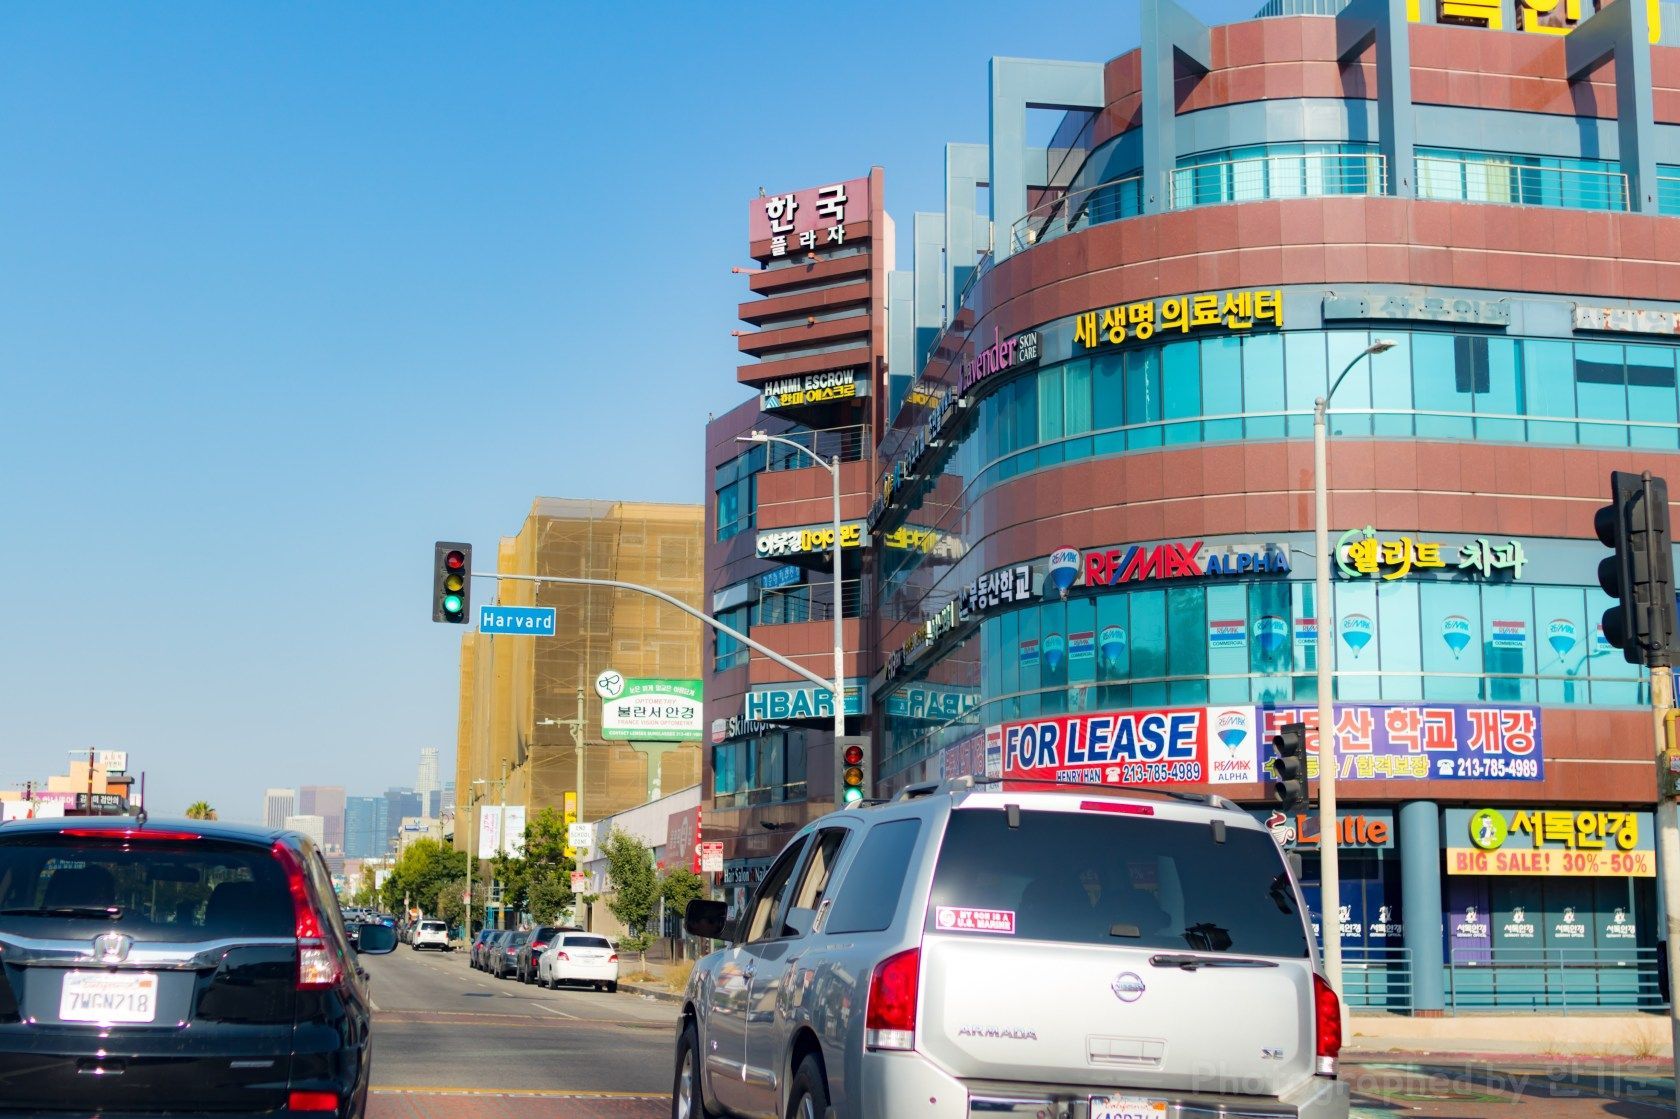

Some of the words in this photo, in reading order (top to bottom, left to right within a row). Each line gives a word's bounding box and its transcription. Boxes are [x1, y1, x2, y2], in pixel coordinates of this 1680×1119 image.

[765, 184, 847, 234] 한국
[770, 224, 846, 257] 플라자
[1019, 332, 1037, 350] SKIN
[1019, 345, 1037, 362] CARE
[765, 377, 801, 396] HANMI
[804, 369, 855, 390] ESCROW
[806, 384, 856, 402] 에스크로
[1051, 550, 1078, 563] RE/MAX
[1085, 540, 1204, 587] RE/MAX
[1207, 551, 1289, 574] ALPHA
[1348, 536, 1446, 580] 엘리트
[1458, 538, 1528, 579] 치과
[483, 612, 551, 629] Harvard
[745, 688, 835, 721] HBAR
[1005, 721, 1060, 772] FOR
[1064, 711, 1200, 767] LEASE
[1385, 708, 1457, 752] 학교
[1466, 708, 1536, 756] 개강
[1056, 769, 1082, 783] HENRY
[1083, 768, 1101, 783] HAN
[1122, 762, 1201, 784] 213-785-4989
[1214, 758, 1252, 772] RE/MAX
[1457, 758, 1538, 778] 213-785-4989
[1218, 772, 1248, 782] ALPHA
[1296, 814, 1389, 844] Ltte
[1508, 810, 1638, 850] 서독안경
[1456, 852, 1488, 871] BIG
[1496, 852, 1550, 872] SALE!
[958, 1024, 1038, 1041] ARMADA
